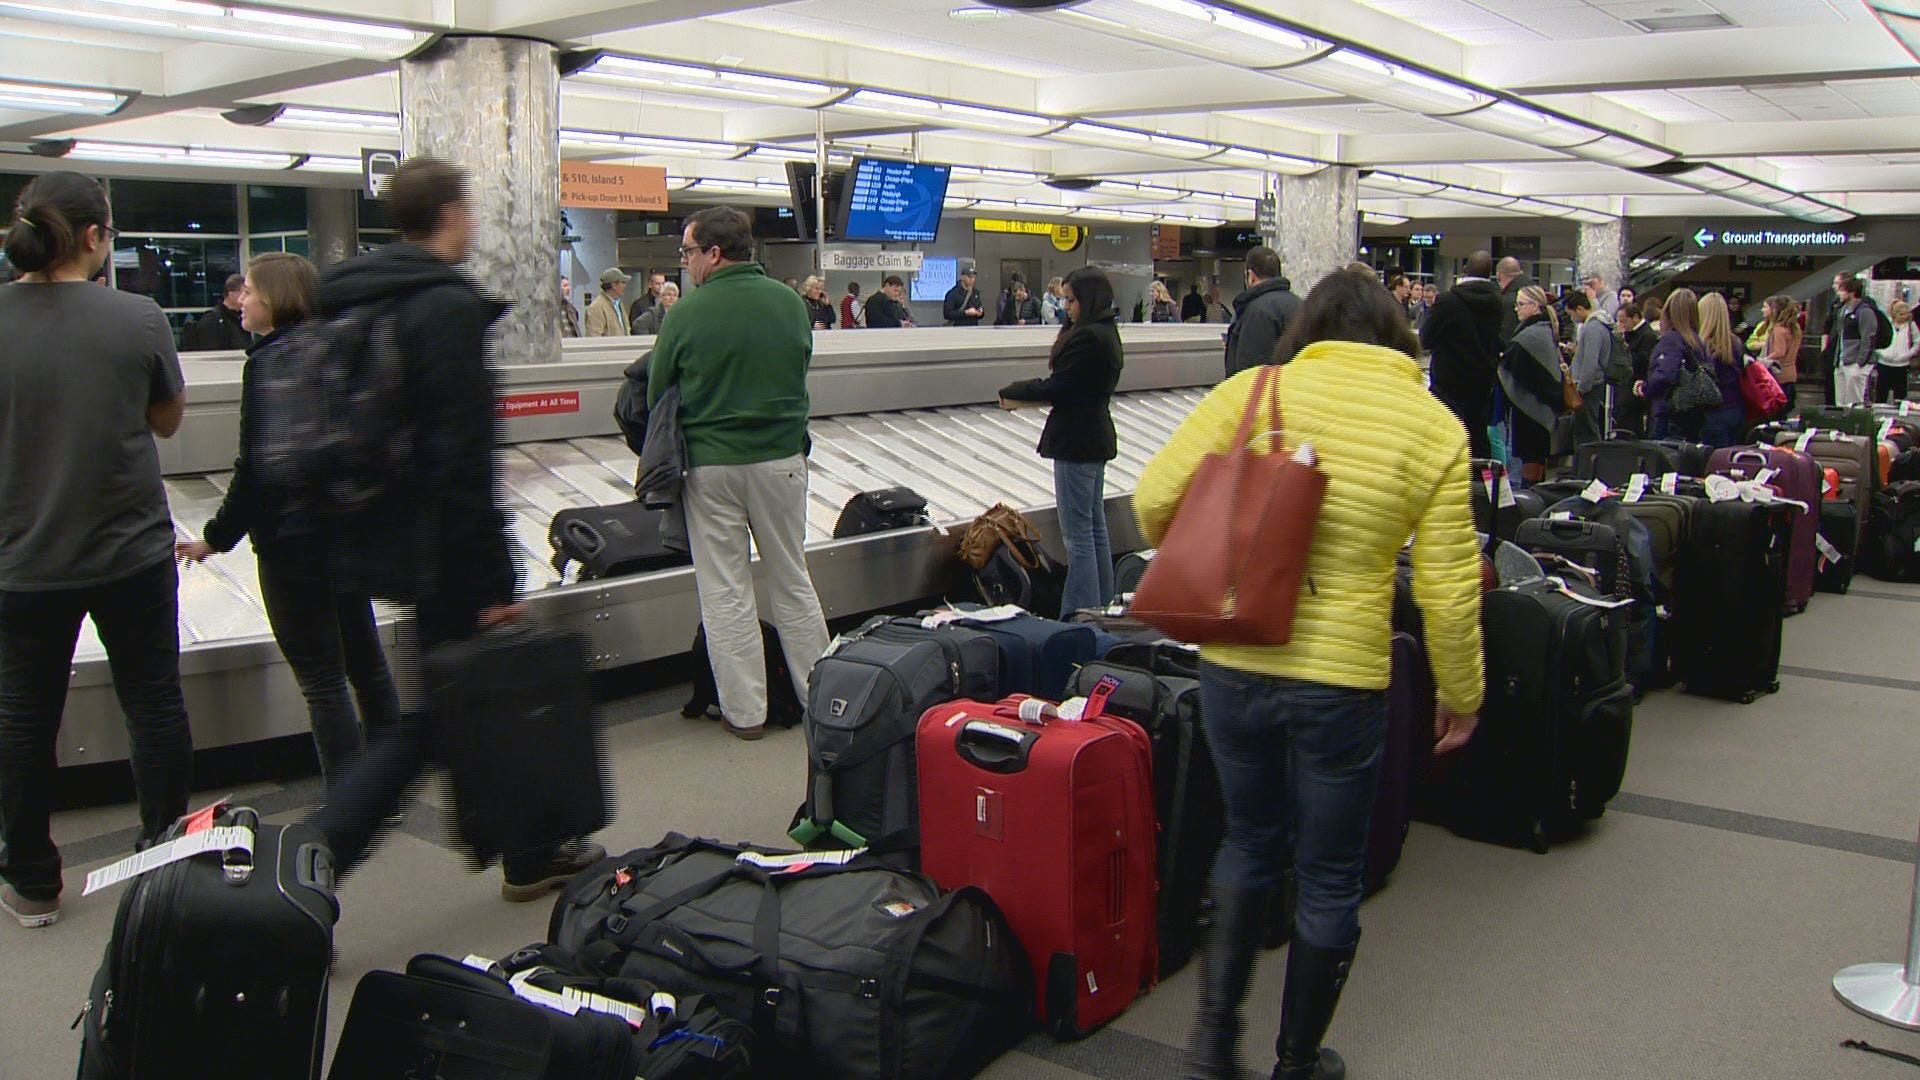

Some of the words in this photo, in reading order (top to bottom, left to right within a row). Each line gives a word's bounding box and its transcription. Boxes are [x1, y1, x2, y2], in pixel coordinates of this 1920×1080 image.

[571, 174, 590, 185] 510,
[592, 175, 617, 185] Island
[619, 176, 625, 186] 5
[571, 192, 599, 203] Pick-up
[600, 193, 618, 203] Door
[658, 196, 662, 204] 5
[1722, 231, 1763, 244] Ground
[1765, 231, 1846, 247] Transportation
[833, 253, 875, 269] Baggage
[877, 254, 902, 267] Claim
[903, 255, 912, 268] 16
[927, 263, 951, 271] SPRING
[924, 271, 955, 280] TRAINING
[505, 400, 539, 411] Equipment
[549, 398, 559, 406] All
[560, 398, 577, 406] Times
